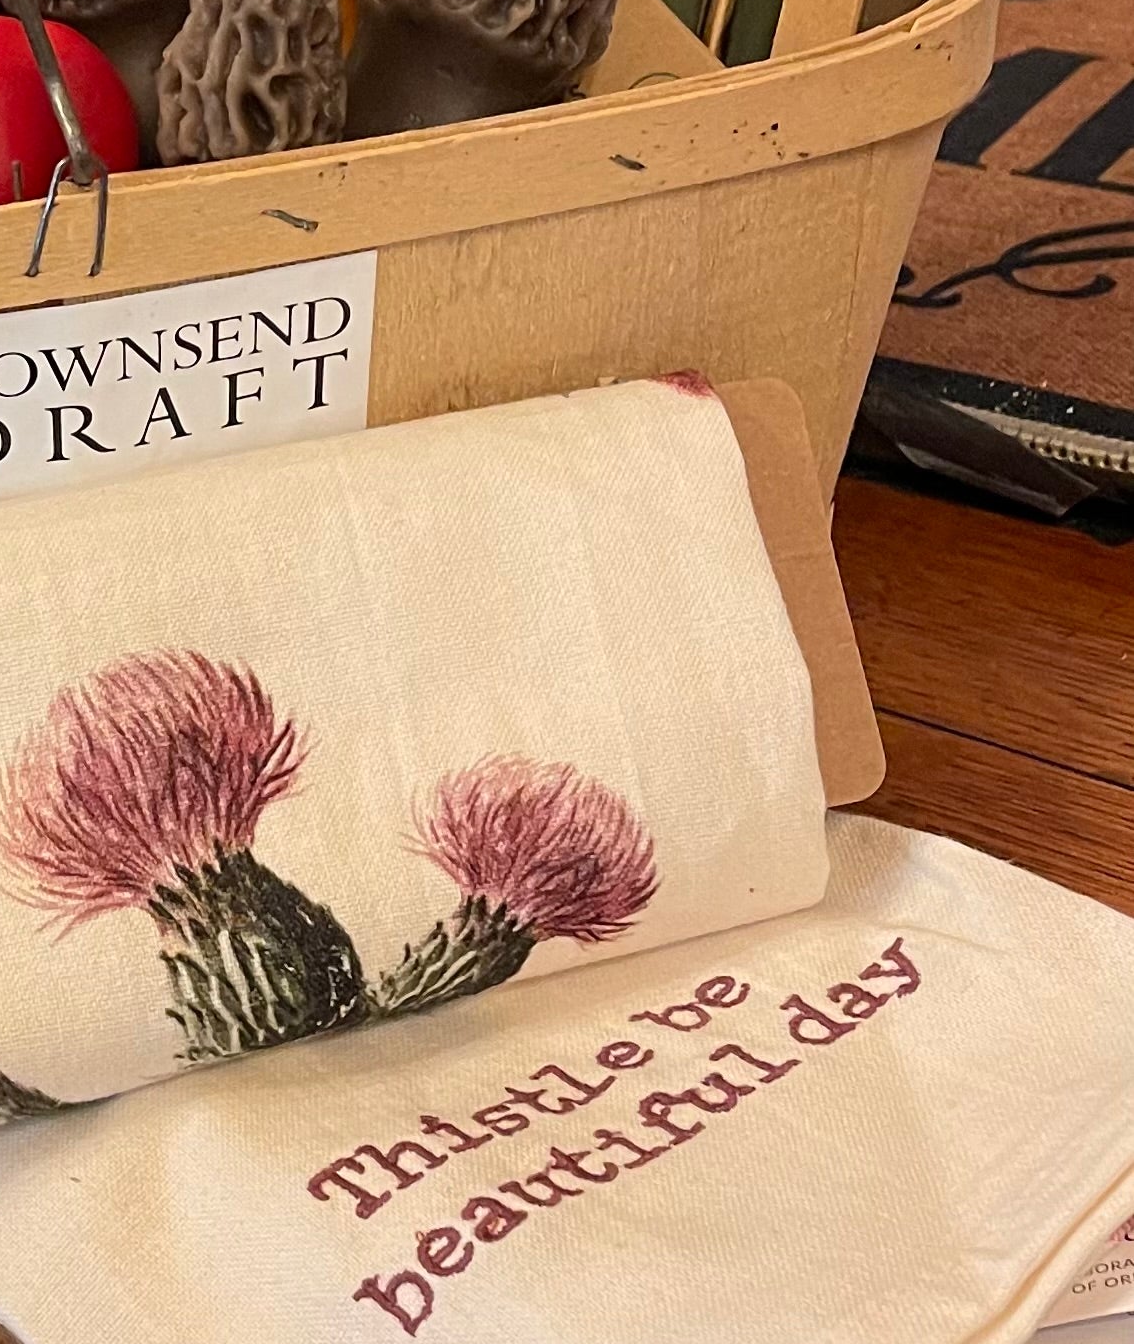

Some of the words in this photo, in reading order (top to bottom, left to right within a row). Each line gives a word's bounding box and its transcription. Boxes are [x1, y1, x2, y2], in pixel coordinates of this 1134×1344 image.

[306, 1038, 656, 1220] Thistle
[629, 974, 752, 1033] be
[351, 1042, 803, 1338] beautiful
[779, 936, 923, 1046] day
[1071, 1279, 1097, 1295] OF
[1104, 1272, 1134, 1288] OR
